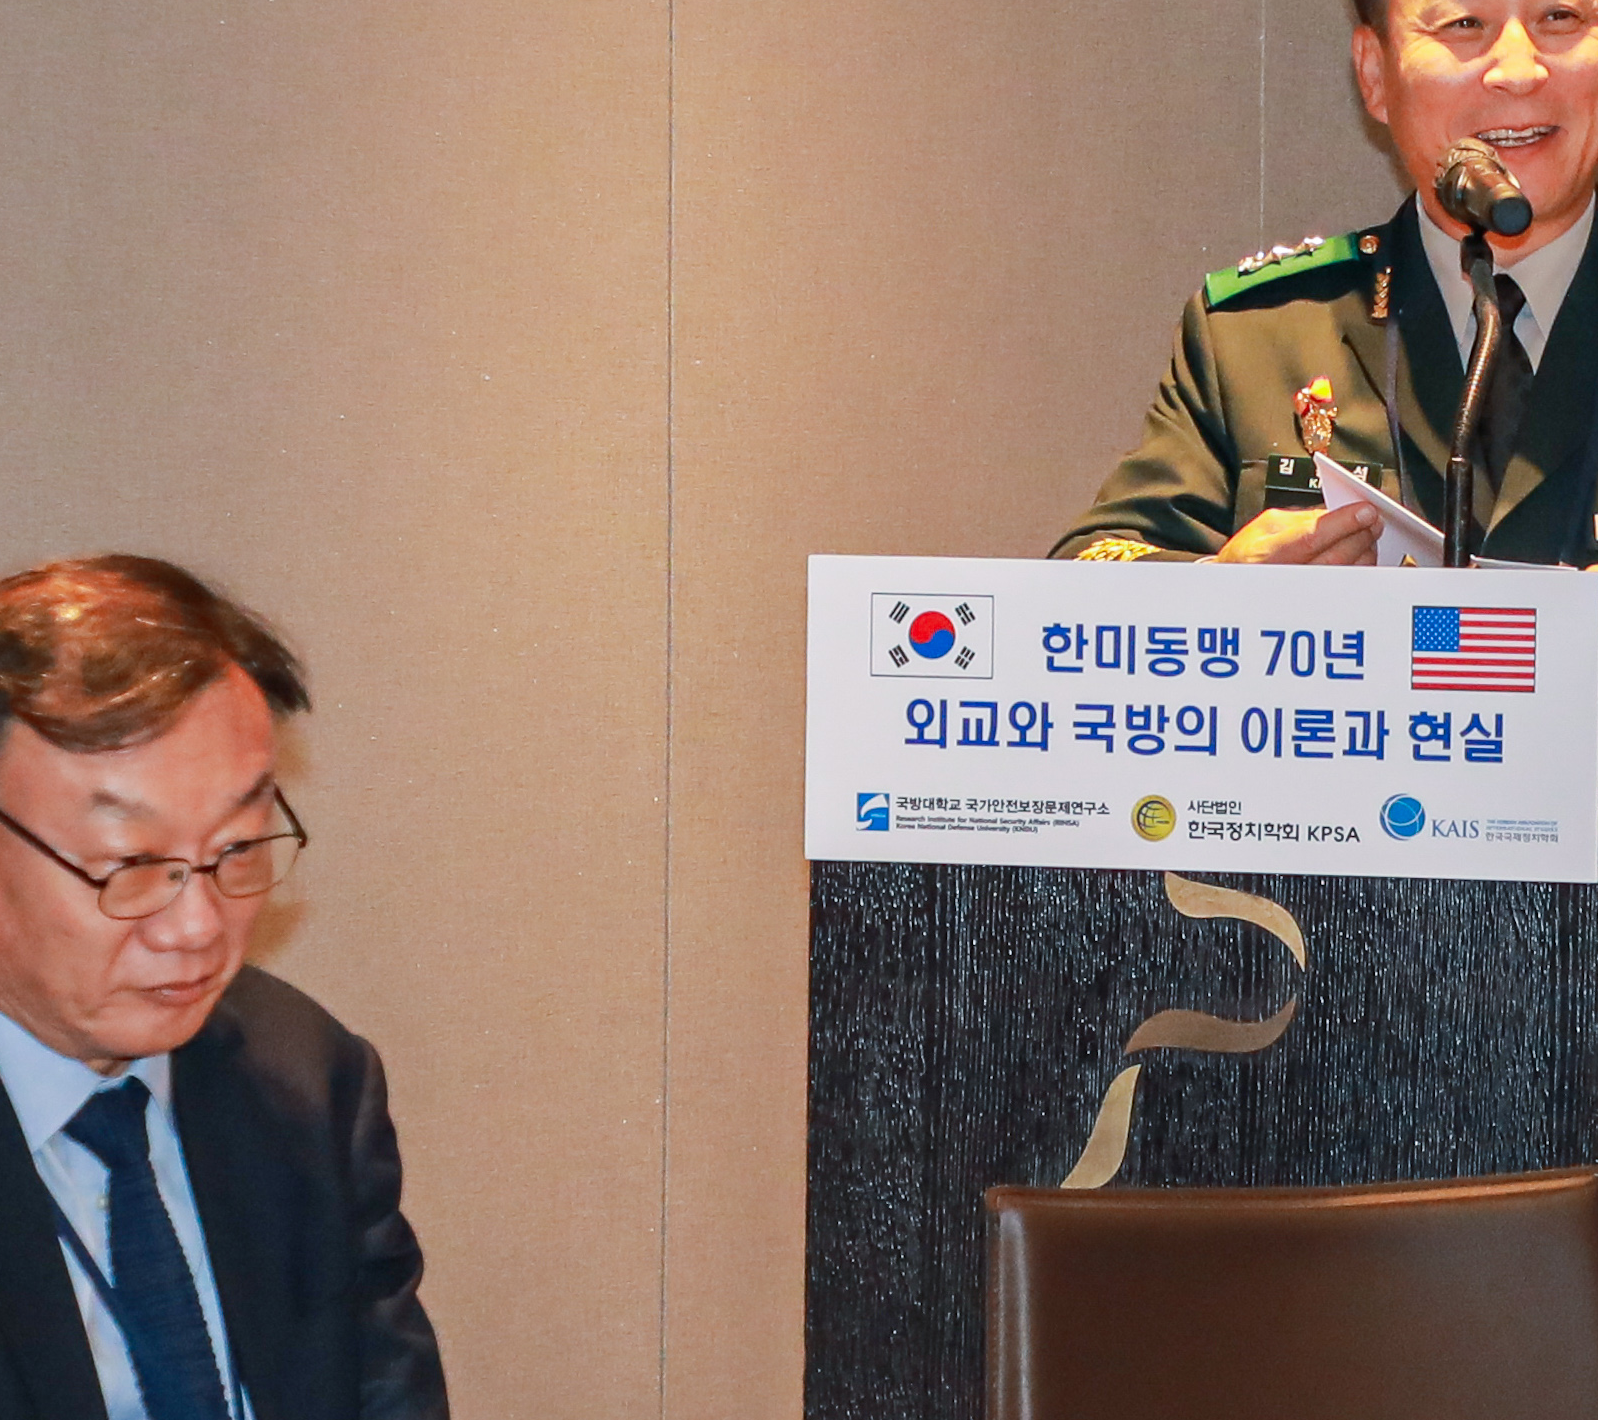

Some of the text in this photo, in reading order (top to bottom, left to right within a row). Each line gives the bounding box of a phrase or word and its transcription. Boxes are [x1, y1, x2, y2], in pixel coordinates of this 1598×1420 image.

[1042, 623, 1364, 680] 한미동맹 70년
[904, 698, 1503, 763] 외교와 국방의 이론과 현실
[895, 796, 1110, 816] 국방대학교 국가안전보장문제연구소
[1187, 800, 1241, 815] 사단법인
[1188, 820, 1360, 842] 한국정치학회 KPSA
[1431, 819, 1480, 839] KAIS
